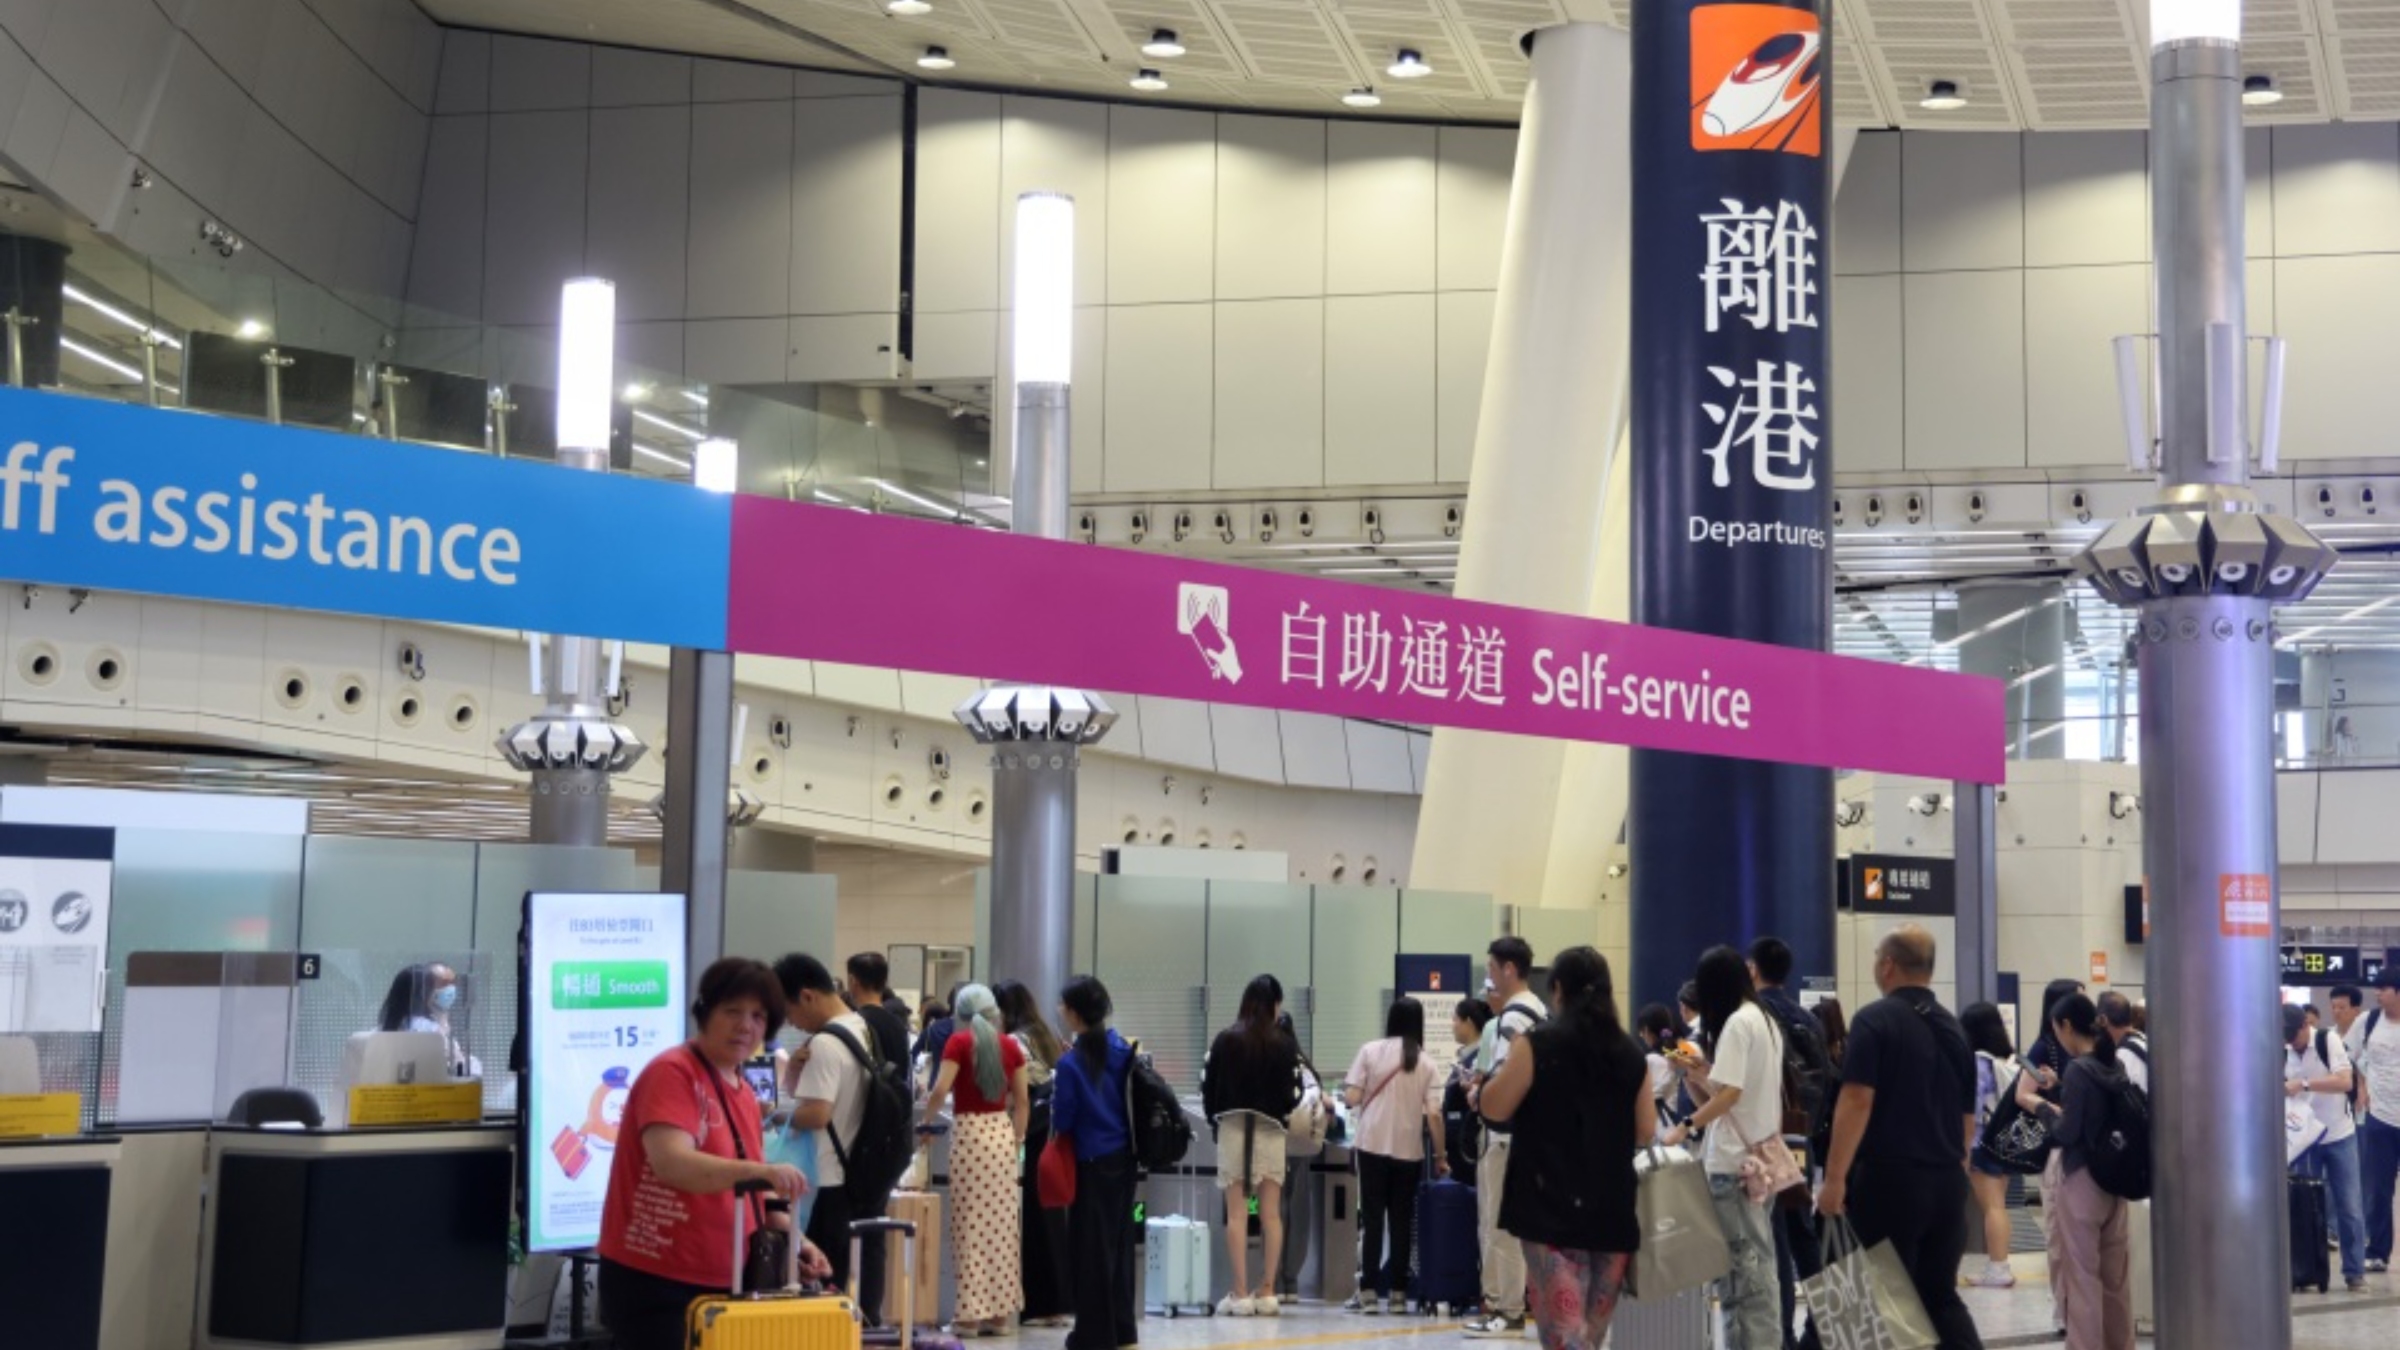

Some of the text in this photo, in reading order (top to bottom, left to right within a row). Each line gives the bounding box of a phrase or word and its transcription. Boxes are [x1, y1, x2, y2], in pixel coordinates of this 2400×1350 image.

[1698, 198, 1819, 491] 離港
[93, 473, 522, 585] assistance
[1688, 515, 1826, 549] Departures
[1281, 601, 1752, 729] 自助通道 Self-service
[304, 958, 315, 976] 6
[609, 979, 661, 995] Smooth
[614, 1026, 639, 1047] 15
